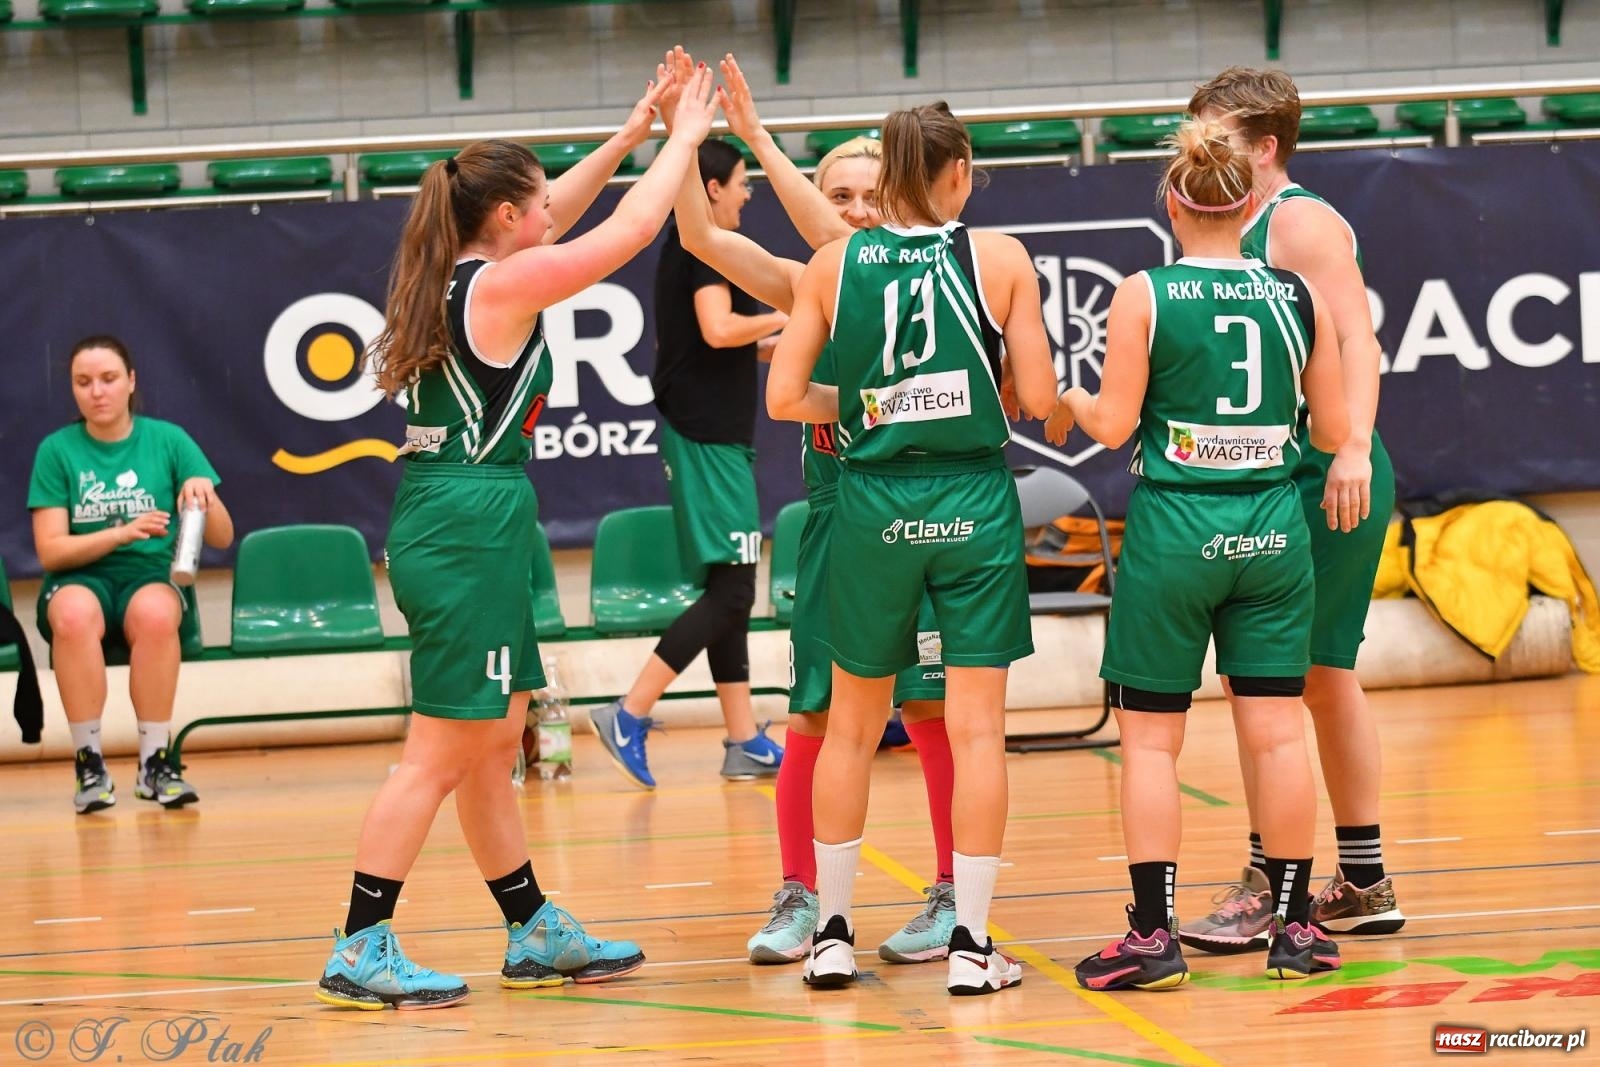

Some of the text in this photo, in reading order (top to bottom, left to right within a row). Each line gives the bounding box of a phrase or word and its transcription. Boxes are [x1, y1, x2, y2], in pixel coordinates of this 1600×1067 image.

[857, 244, 891, 264] RKK
[1167, 276, 1298, 301] RKK RACIBÓRZ
[882, 269, 936, 377] 13
[1214, 315, 1262, 415] 3
[530, 412, 658, 461] BÓRZ
[1197, 435, 1265, 446] wydawnictwo
[904, 517, 974, 539] Clavis
[1223, 529, 1287, 555] Clavis
[486, 646, 512, 694] 4
